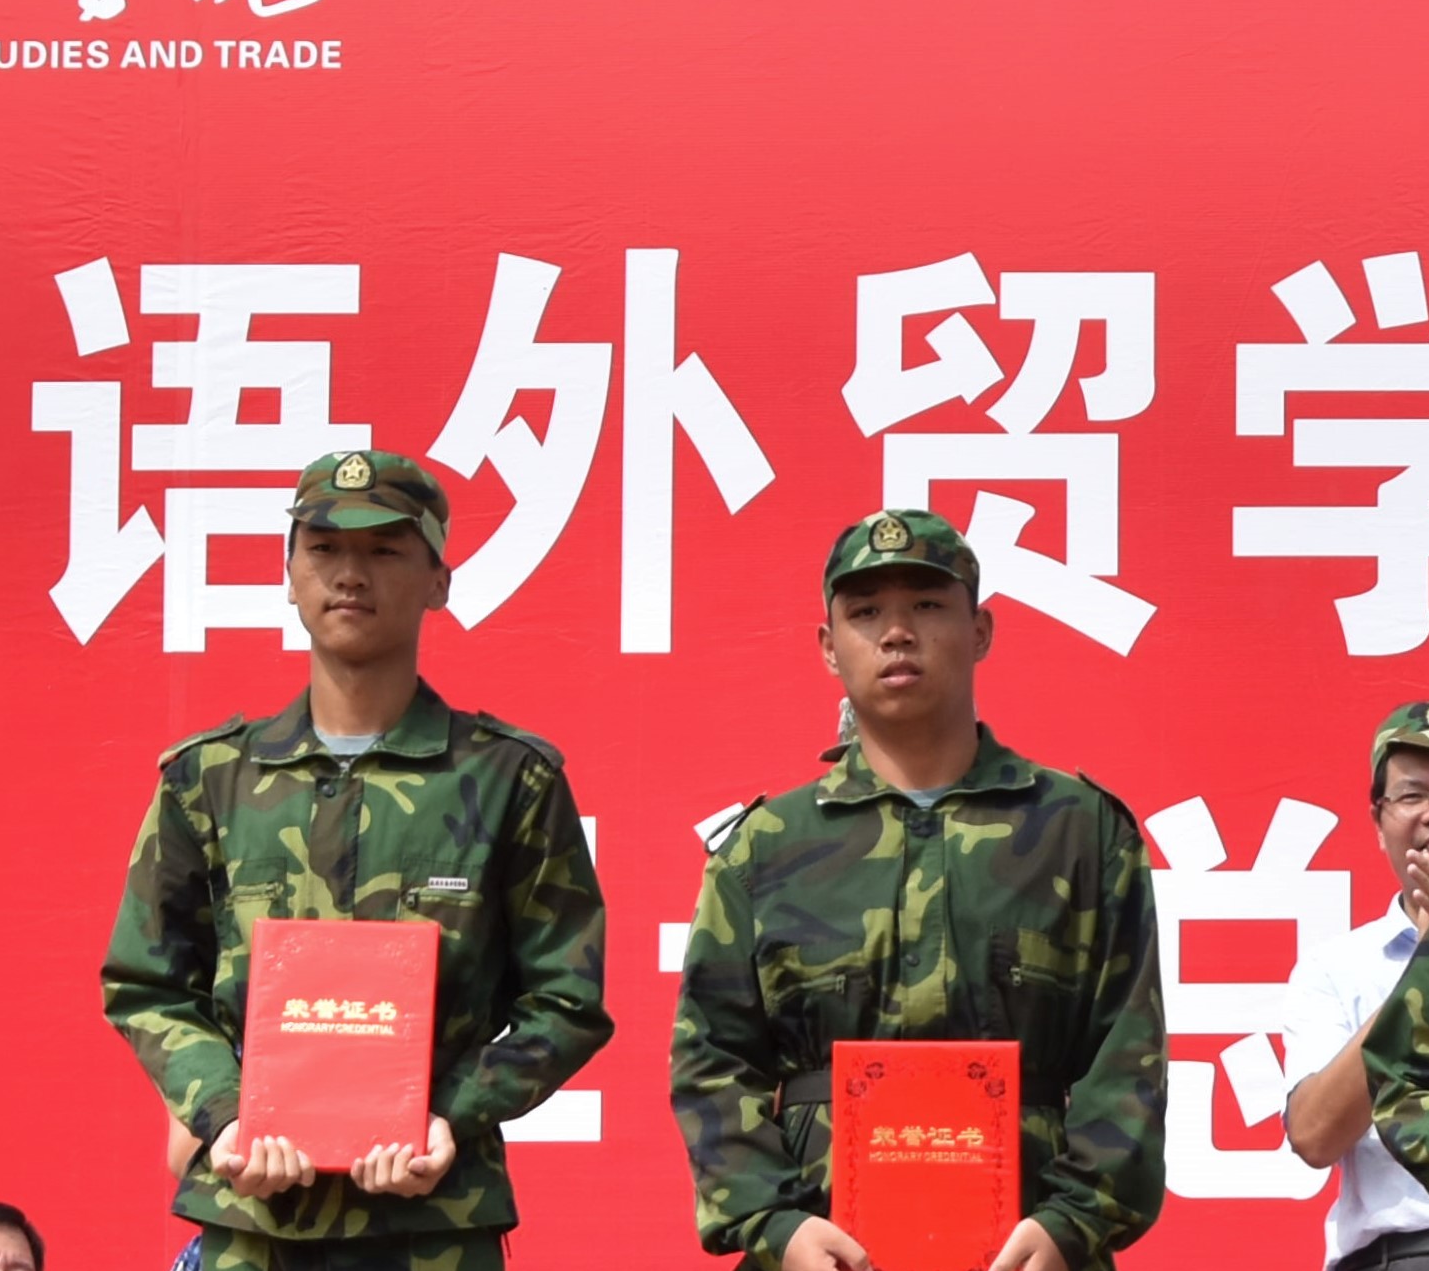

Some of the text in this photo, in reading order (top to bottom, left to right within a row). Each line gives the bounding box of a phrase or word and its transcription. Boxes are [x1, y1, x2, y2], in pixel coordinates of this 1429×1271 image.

[121, 40, 202, 69] AND
[214, 40, 341, 69] TRADE
[282, 998, 397, 1021] 荣誉证书
[870, 1126, 984, 1147] 荣誉证书
